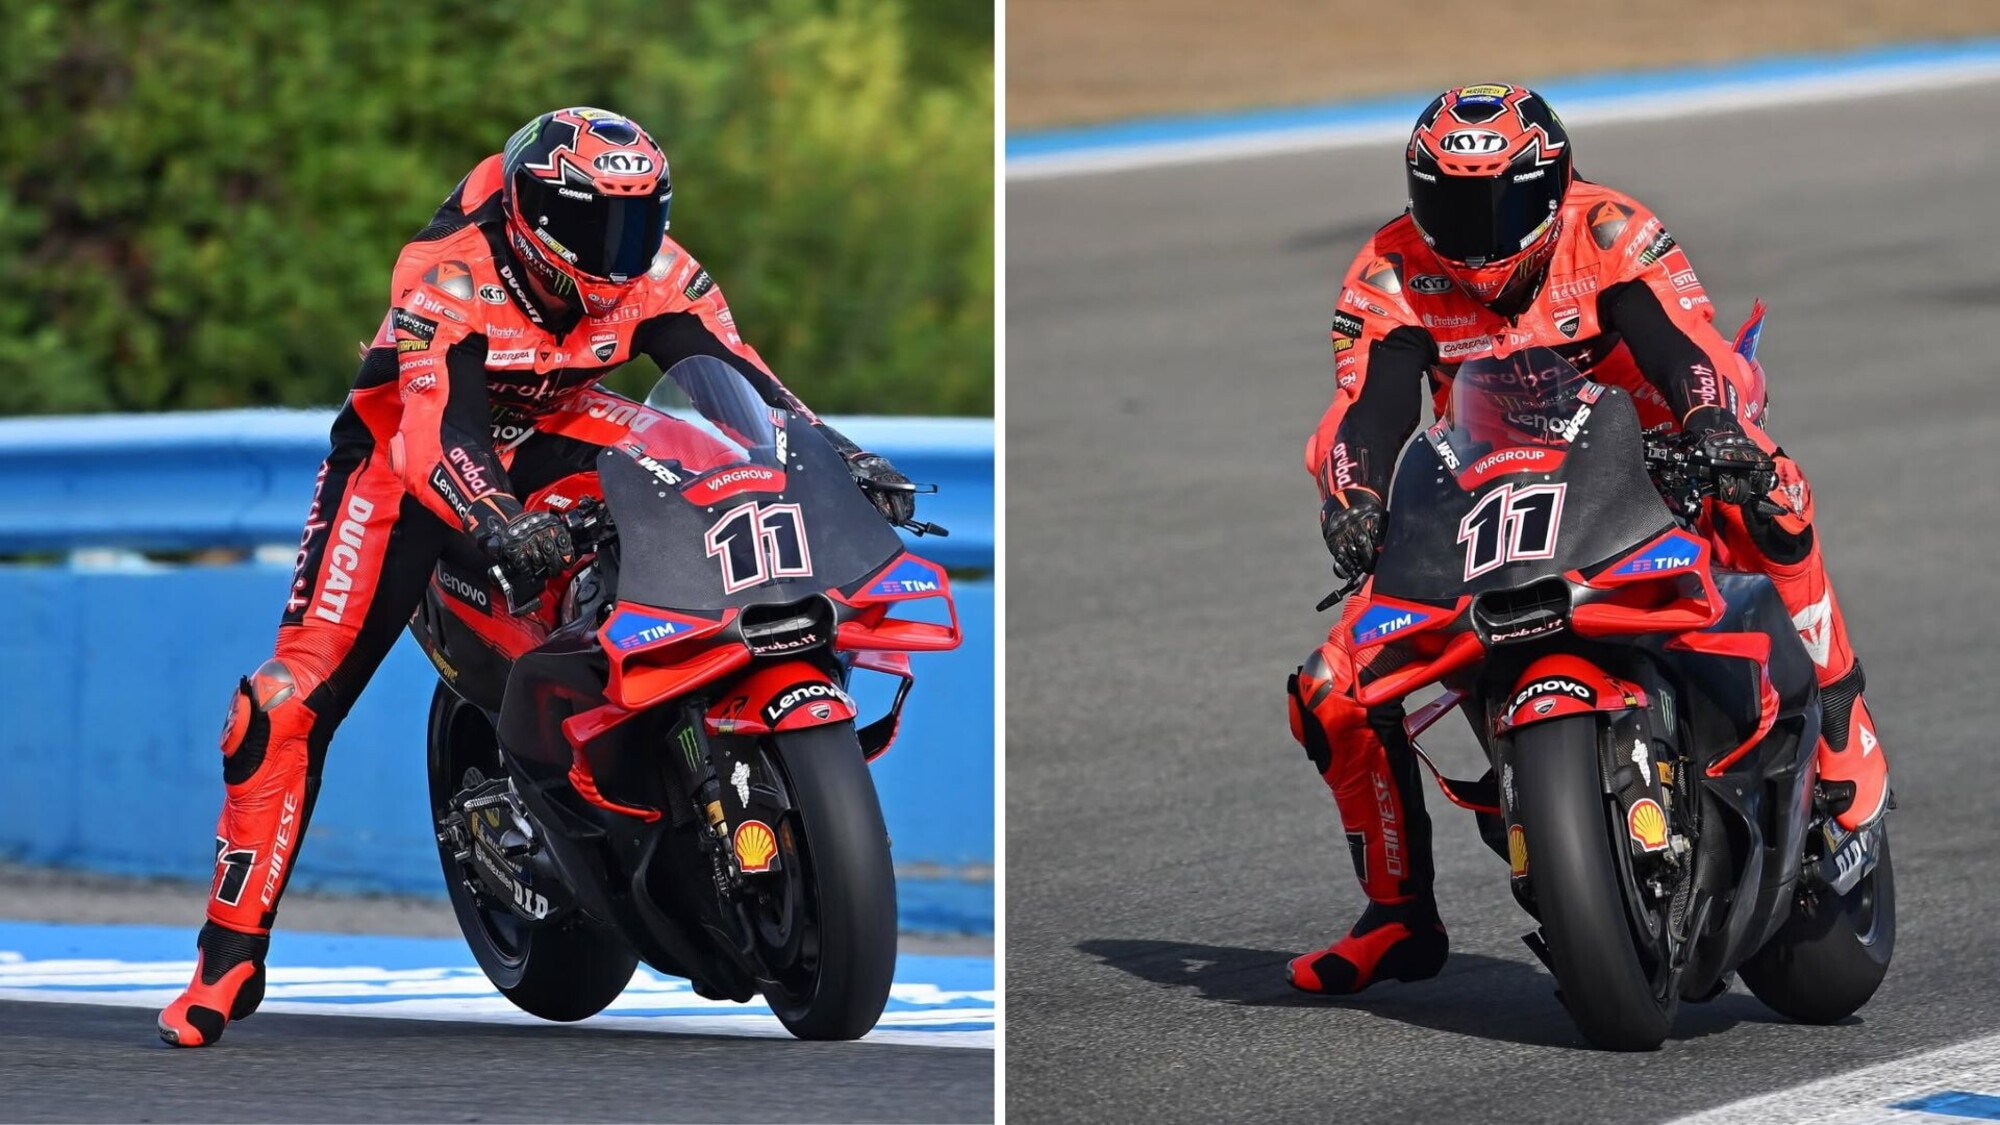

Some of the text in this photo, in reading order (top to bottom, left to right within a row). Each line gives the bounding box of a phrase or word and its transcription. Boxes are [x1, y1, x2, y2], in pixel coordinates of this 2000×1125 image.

[1446, 134, 1503, 152] KYT
[598, 153, 650, 173] KYT
[500, 265, 544, 323] DUCATI
[1418, 277, 1447, 289] KYT
[400, 357, 433, 371] otorola
[1507, 411, 1572, 434] Leno
[1474, 449, 1546, 475] VARGROUP
[706, 469, 774, 491] VARGROUP
[1456, 482, 1568, 583] 11
[704, 501, 814, 595] 11
[314, 494, 375, 625] DUCATI
[1654, 556, 1691, 570] TIM
[436, 566, 488, 607] Lenovo
[900, 579, 937, 592] TIM
[638, 622, 676, 643] TIM
[1379, 613, 1413, 635] TIM
[261, 792, 298, 907] DAINESE
